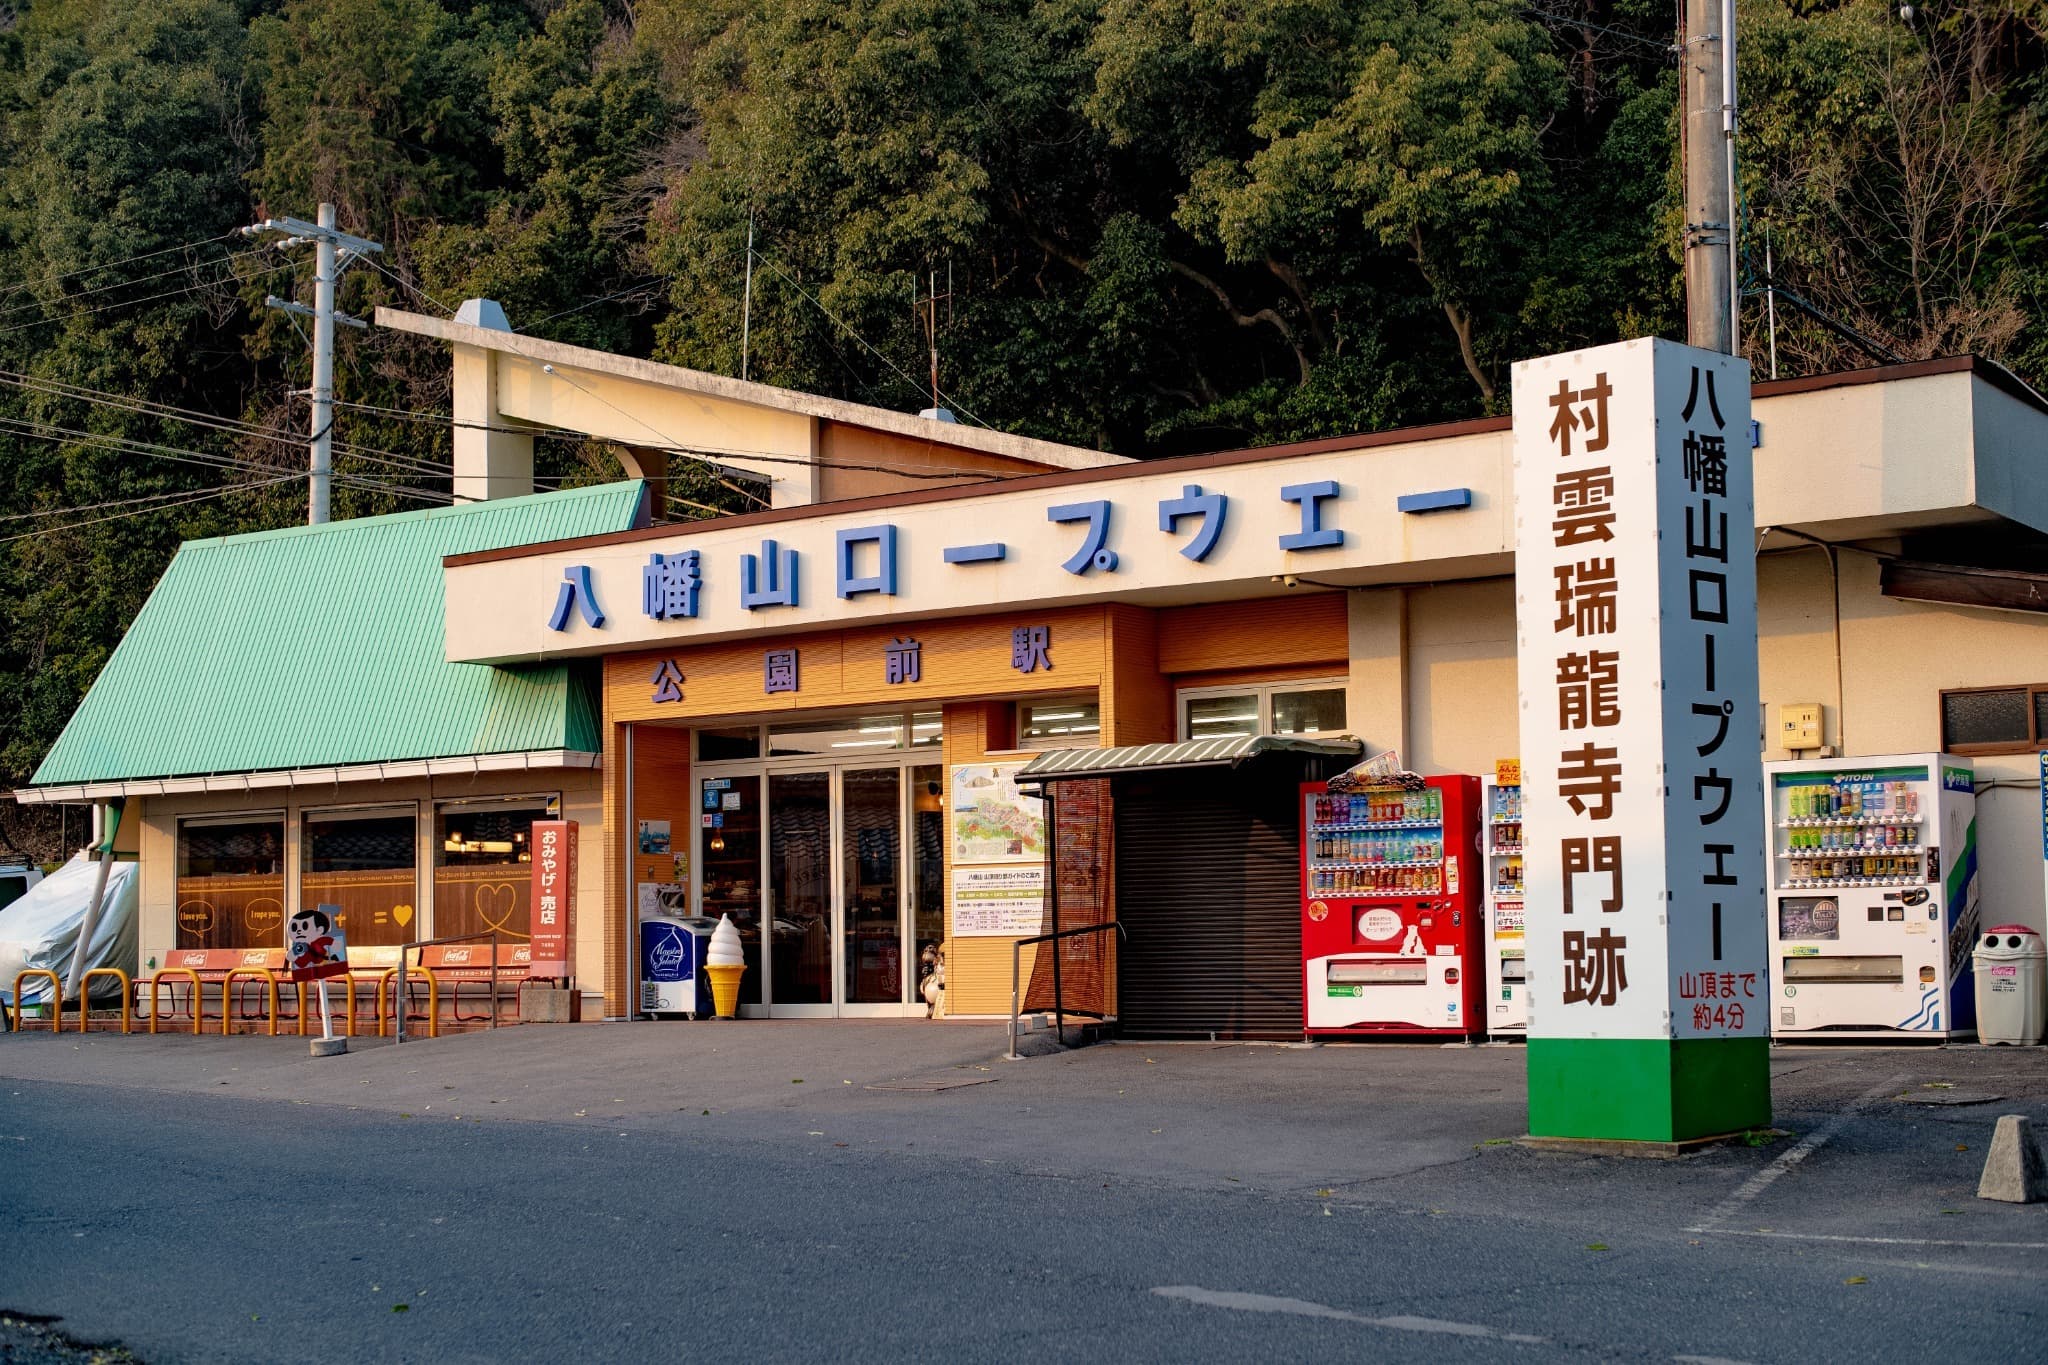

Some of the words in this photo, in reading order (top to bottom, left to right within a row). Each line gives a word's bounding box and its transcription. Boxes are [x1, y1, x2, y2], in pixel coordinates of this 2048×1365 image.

[650, 624, 1052, 704] 公園前駅
[1548, 371, 1628, 1007] 村雲瑞龍寺門跡
[1845, 774, 1860, 782] ITO
[540, 830, 558, 925] おみやげ・売店
[444, 949, 469, 962] Coca-Cola
[1679, 971, 1756, 999] 山頂まで
[1692, 1003, 1745, 1031] 約4分
